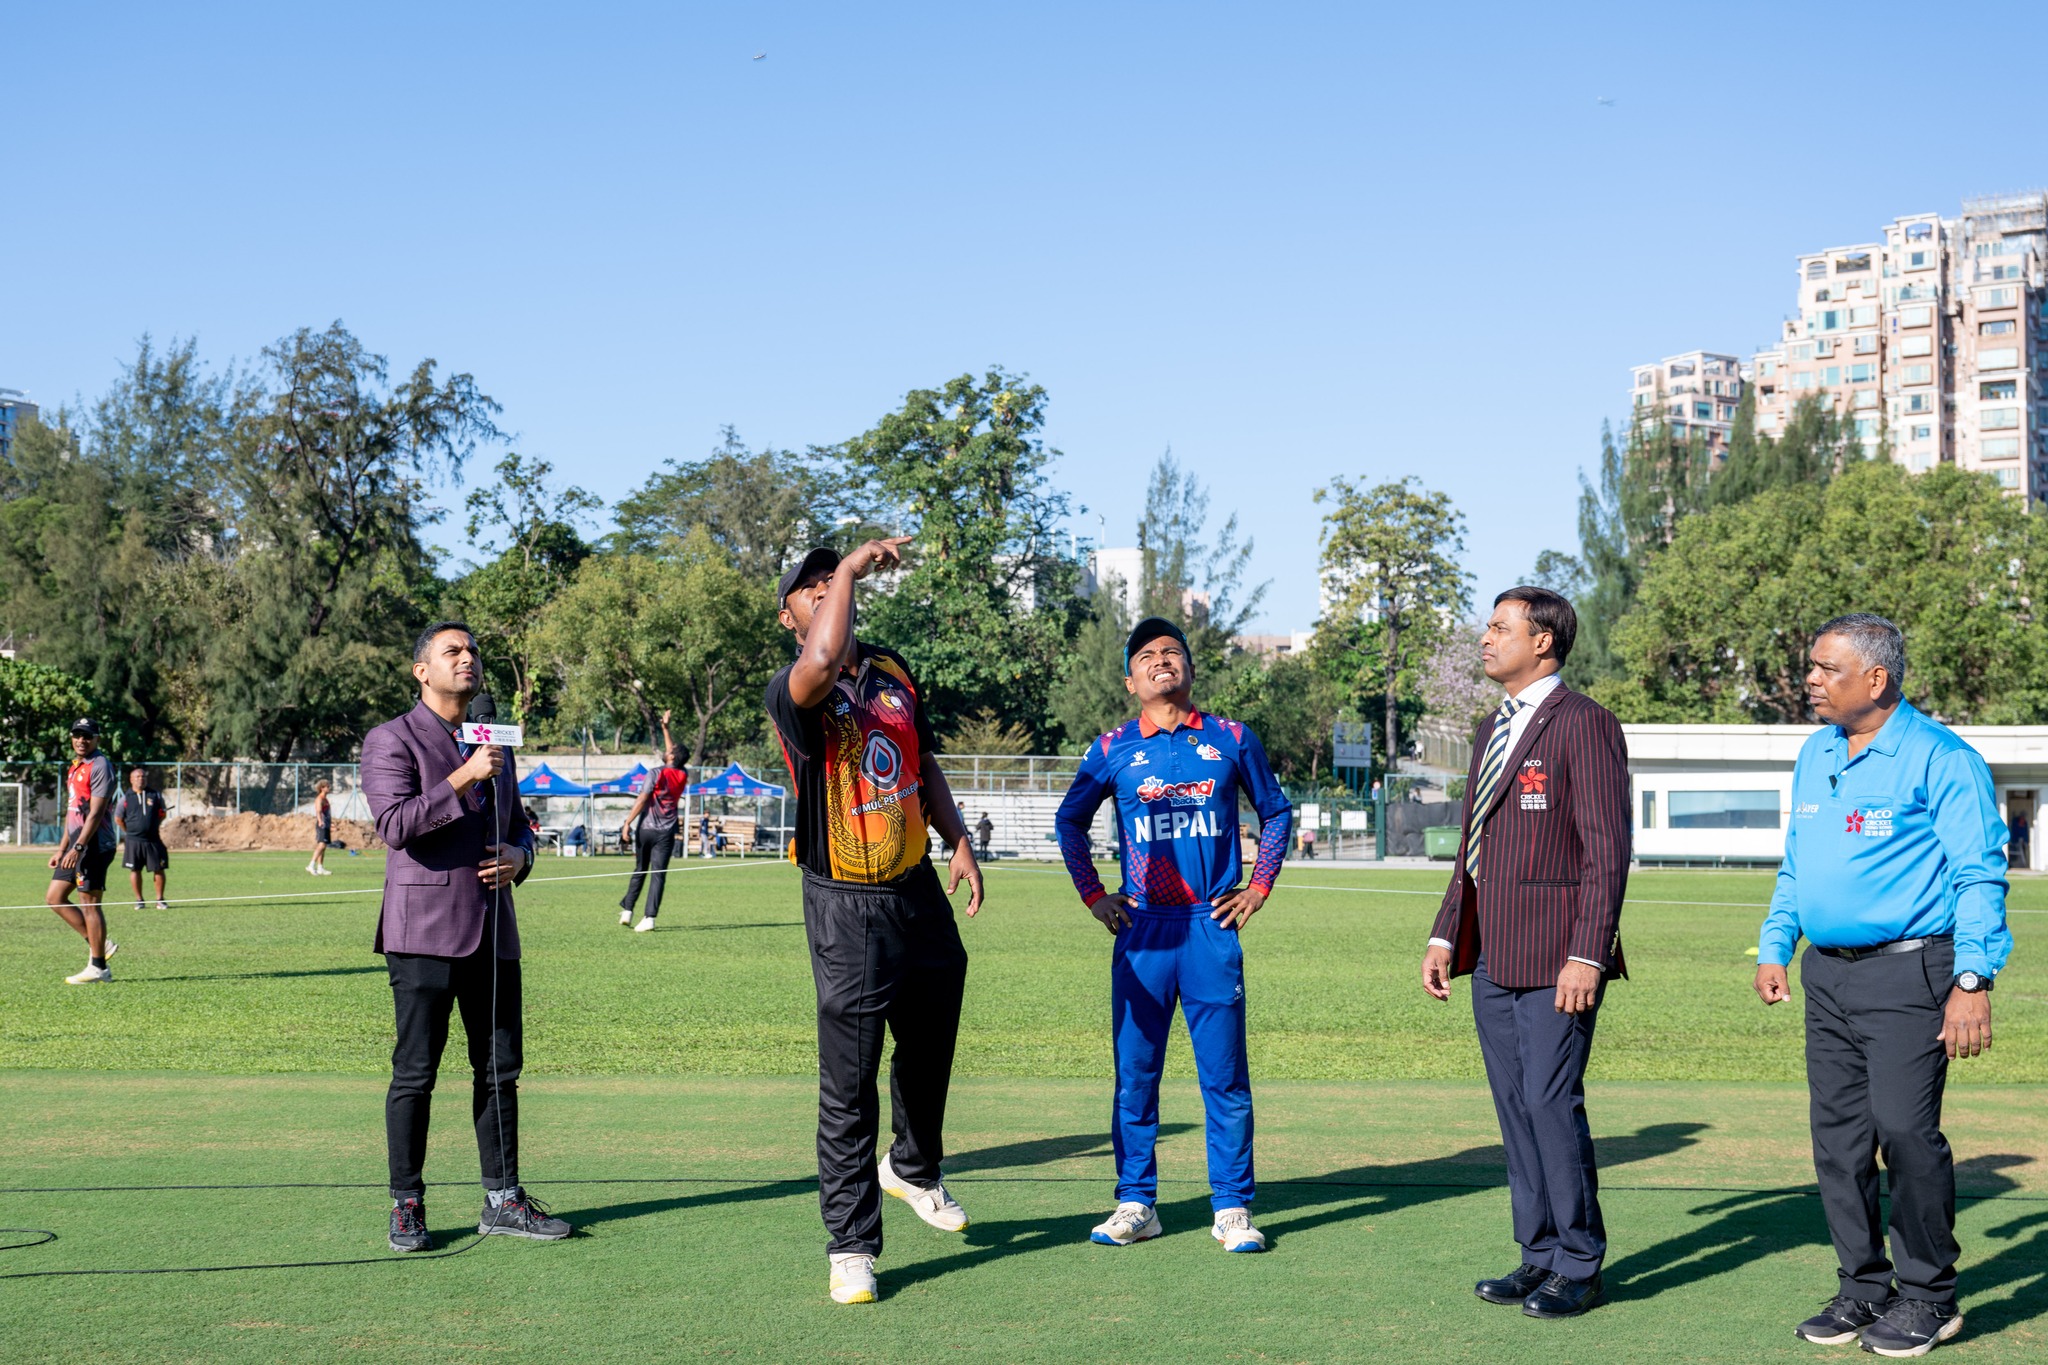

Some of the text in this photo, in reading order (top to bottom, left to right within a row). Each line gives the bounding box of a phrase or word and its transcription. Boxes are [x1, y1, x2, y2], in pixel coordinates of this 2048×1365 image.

[1523, 759, 1542, 767] ACO
[1146, 776, 1161, 789] My
[1137, 779, 1215, 803] Second
[851, 800, 883, 816] KUMUL
[1170, 796, 1205, 807] Teacher
[1865, 809, 1893, 819] ACO
[1134, 811, 1222, 843] NEPAL
